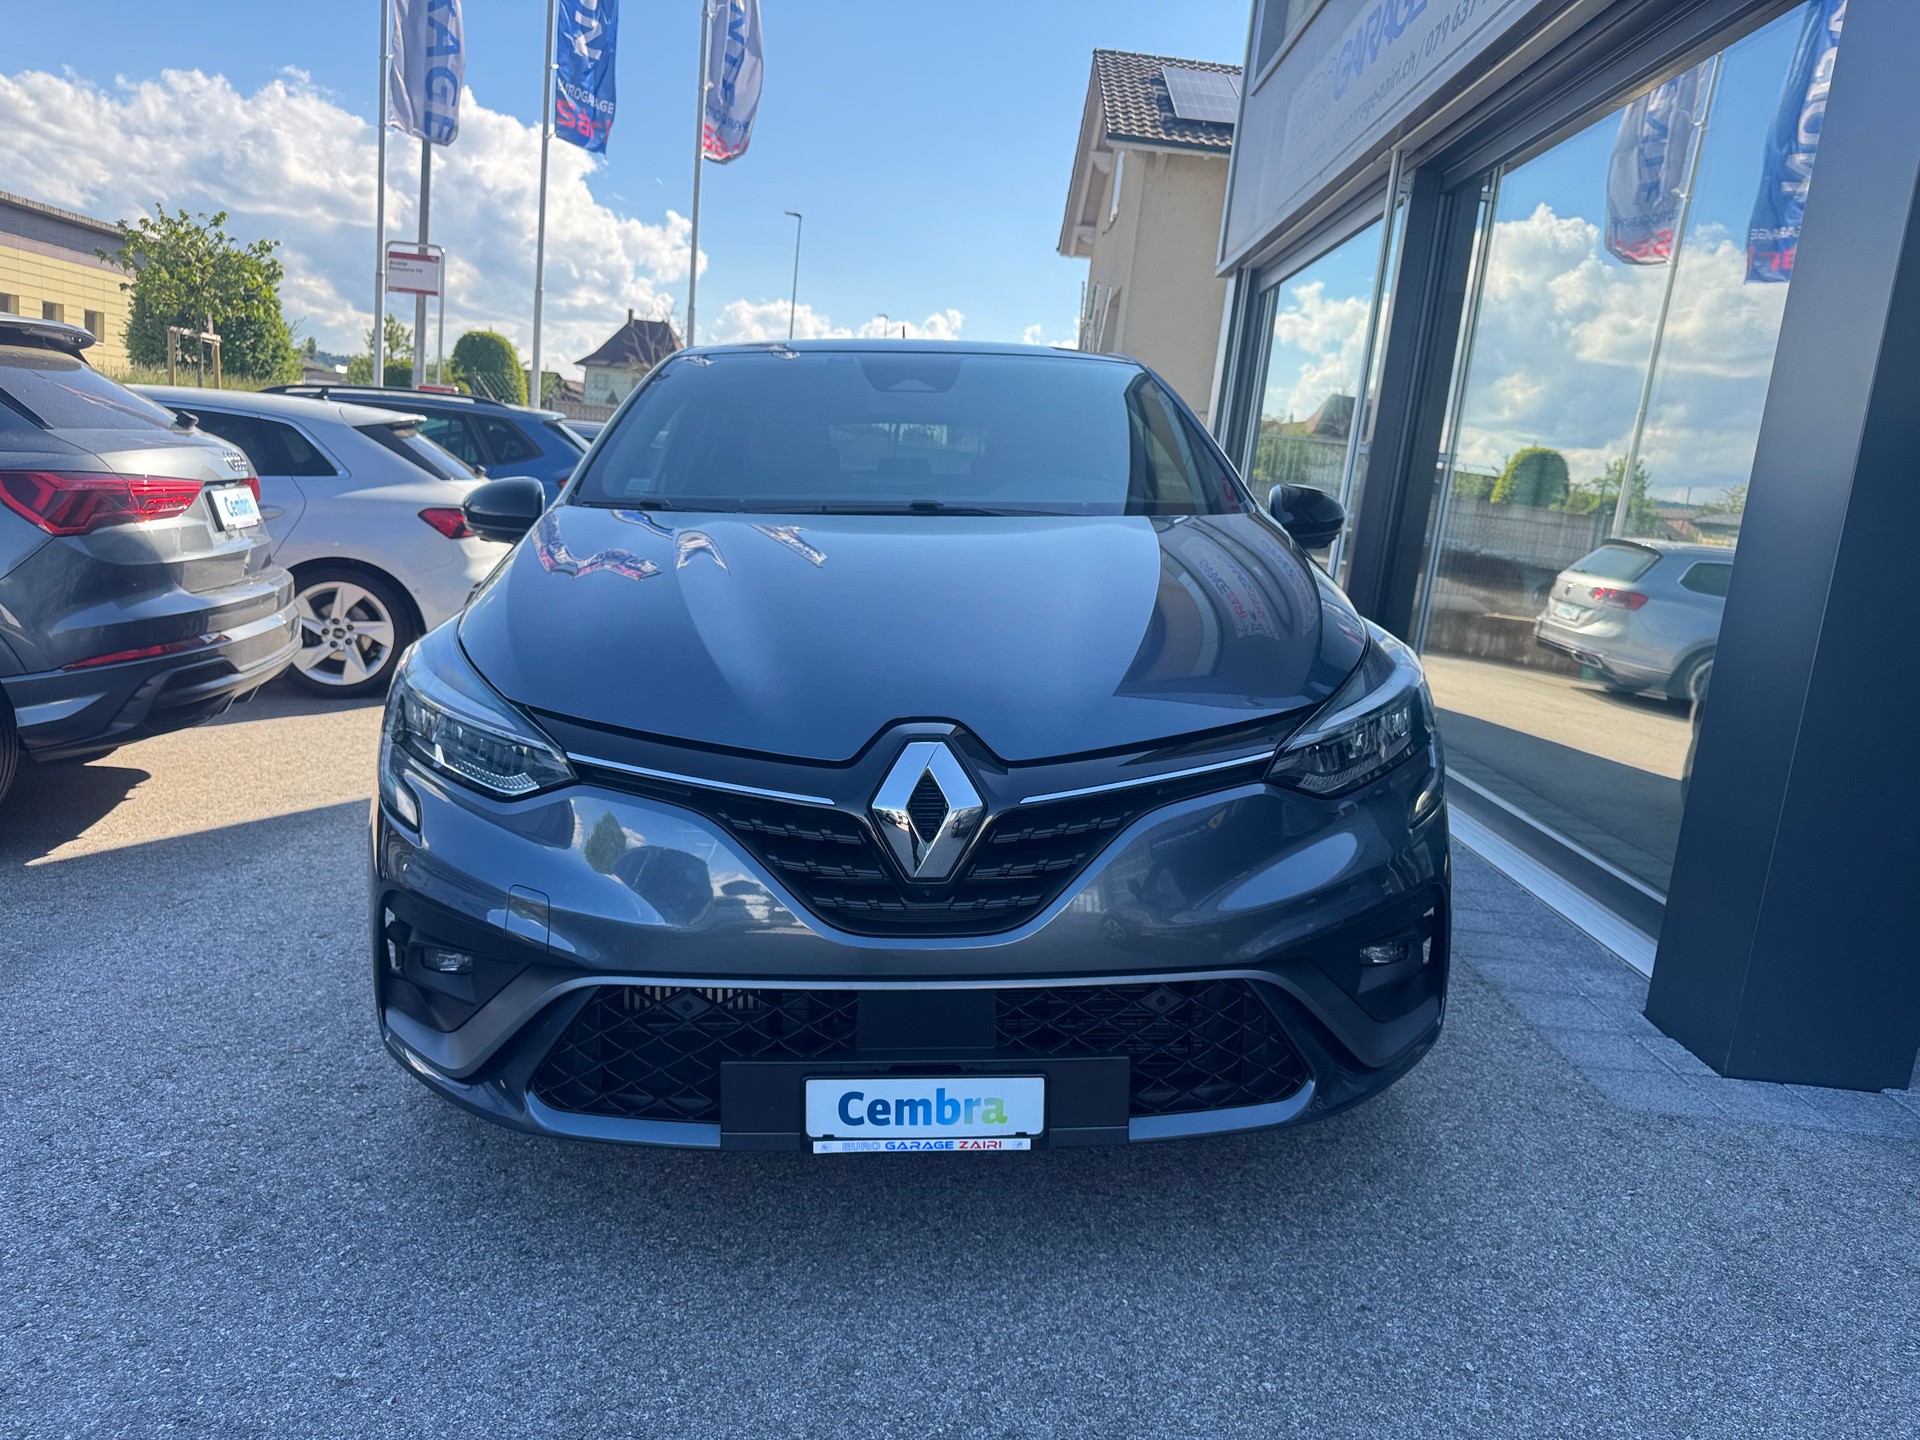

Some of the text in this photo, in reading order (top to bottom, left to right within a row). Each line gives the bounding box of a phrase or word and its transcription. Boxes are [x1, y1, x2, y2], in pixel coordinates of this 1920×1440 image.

[1425, 14, 1451, 58] 079
[224, 493, 253, 517] Cembra
[838, 1087, 1008, 1126] Cembra
[842, 1140, 1002, 1151] EURO GARAGE ZAIRI
